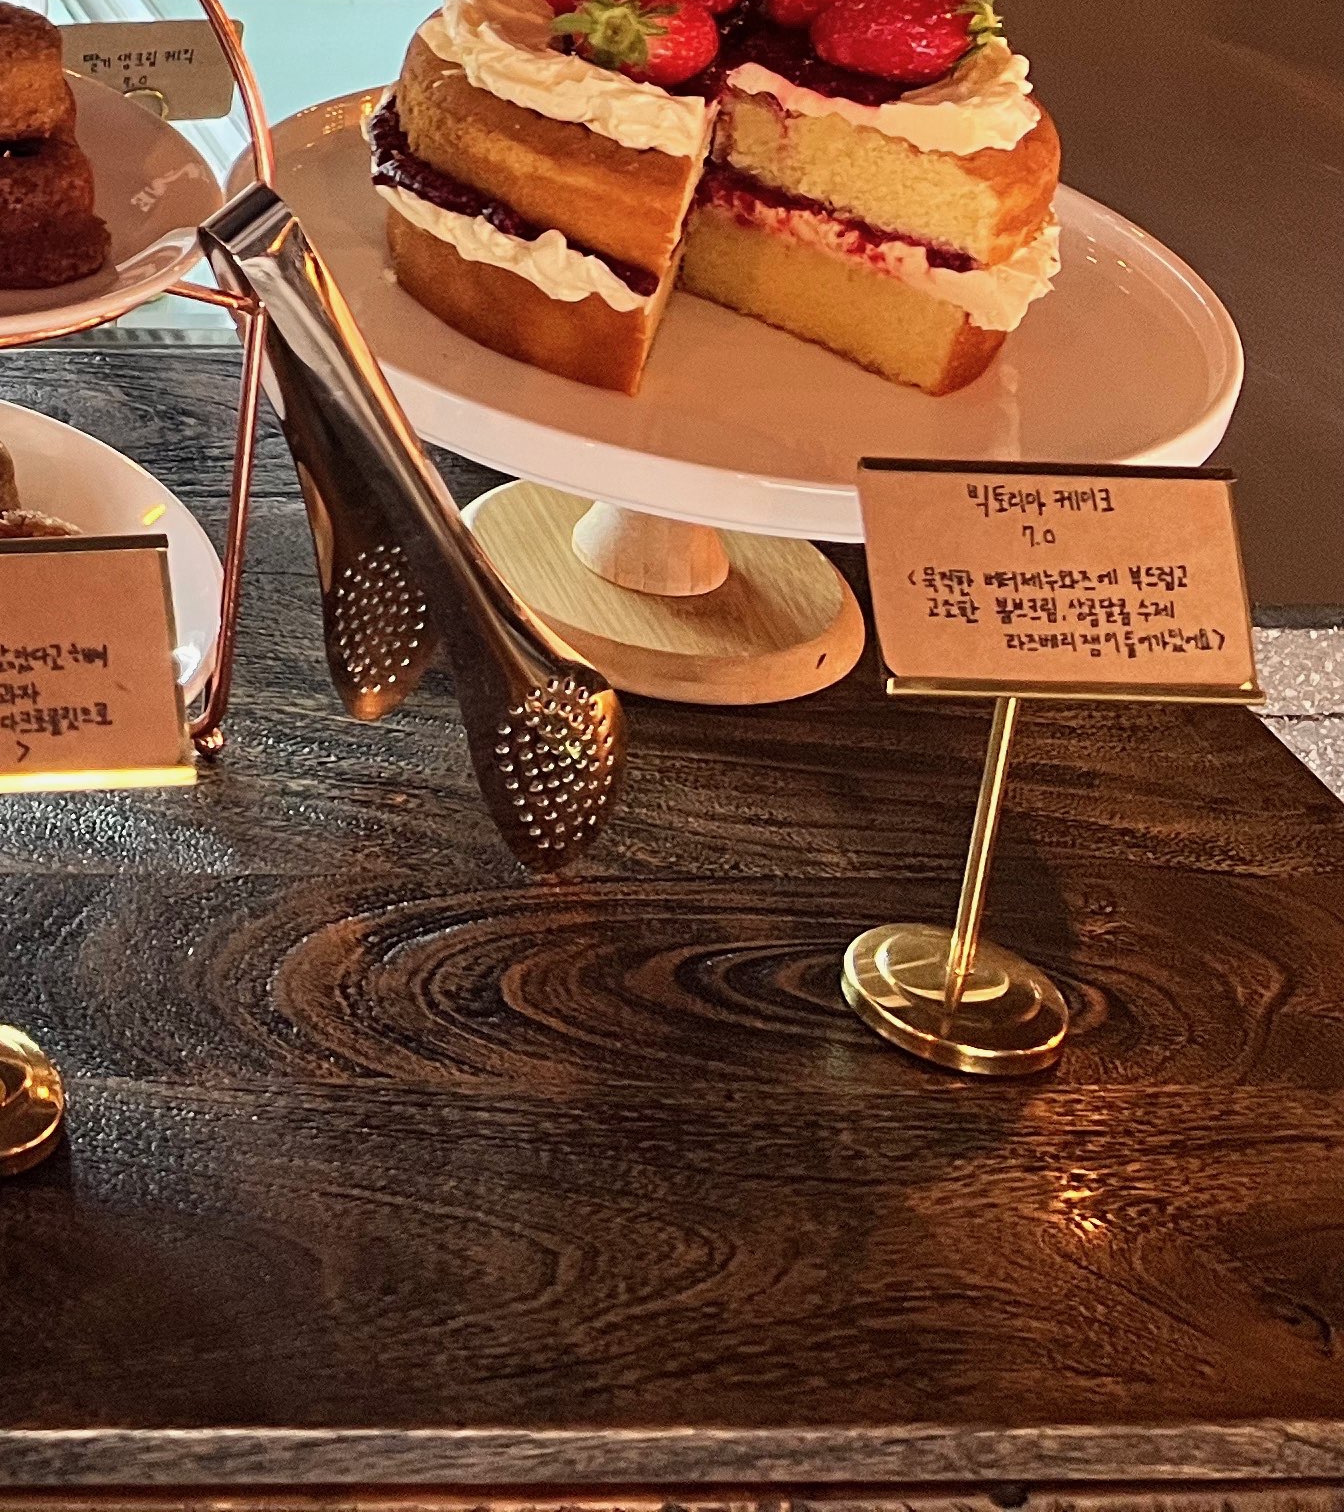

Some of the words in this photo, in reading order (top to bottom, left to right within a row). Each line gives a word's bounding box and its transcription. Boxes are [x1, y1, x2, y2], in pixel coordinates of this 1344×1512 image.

[83, 53, 111, 74] 딸기
[117, 50, 158, 70] 생크림
[164, 48, 194, 65] 케익
[966, 483, 1046, 518] 빅토리아
[1053, 487, 1115, 513] 케이크
[1022, 524, 1056, 548] 7.0
[1128, 565, 1188, 591] 부드럽고
[926, 597, 980, 624] 고소한
[1137, 598, 1176, 623] 수제
[1003, 631, 1078, 652] 라즈베리
